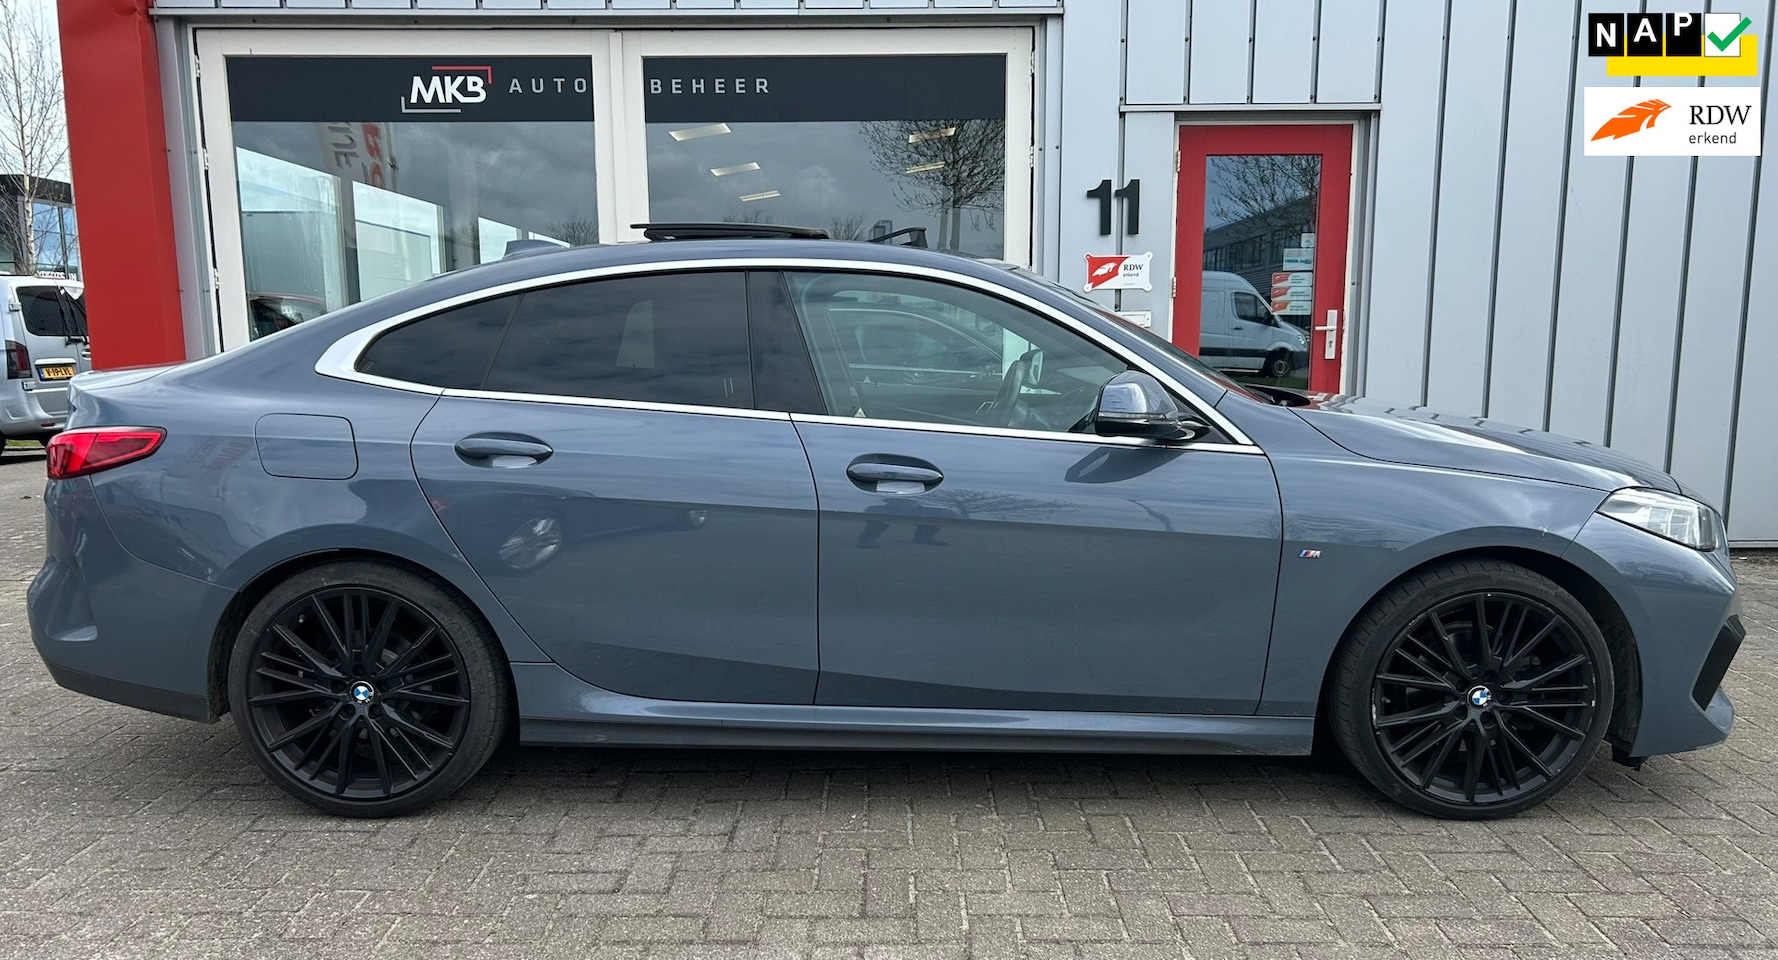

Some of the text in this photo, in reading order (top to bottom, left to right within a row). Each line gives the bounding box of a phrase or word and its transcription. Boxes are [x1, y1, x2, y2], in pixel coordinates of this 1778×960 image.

[410, 75, 769, 104] MKB AUTO BEHEER
[1086, 179, 1140, 235] 11
